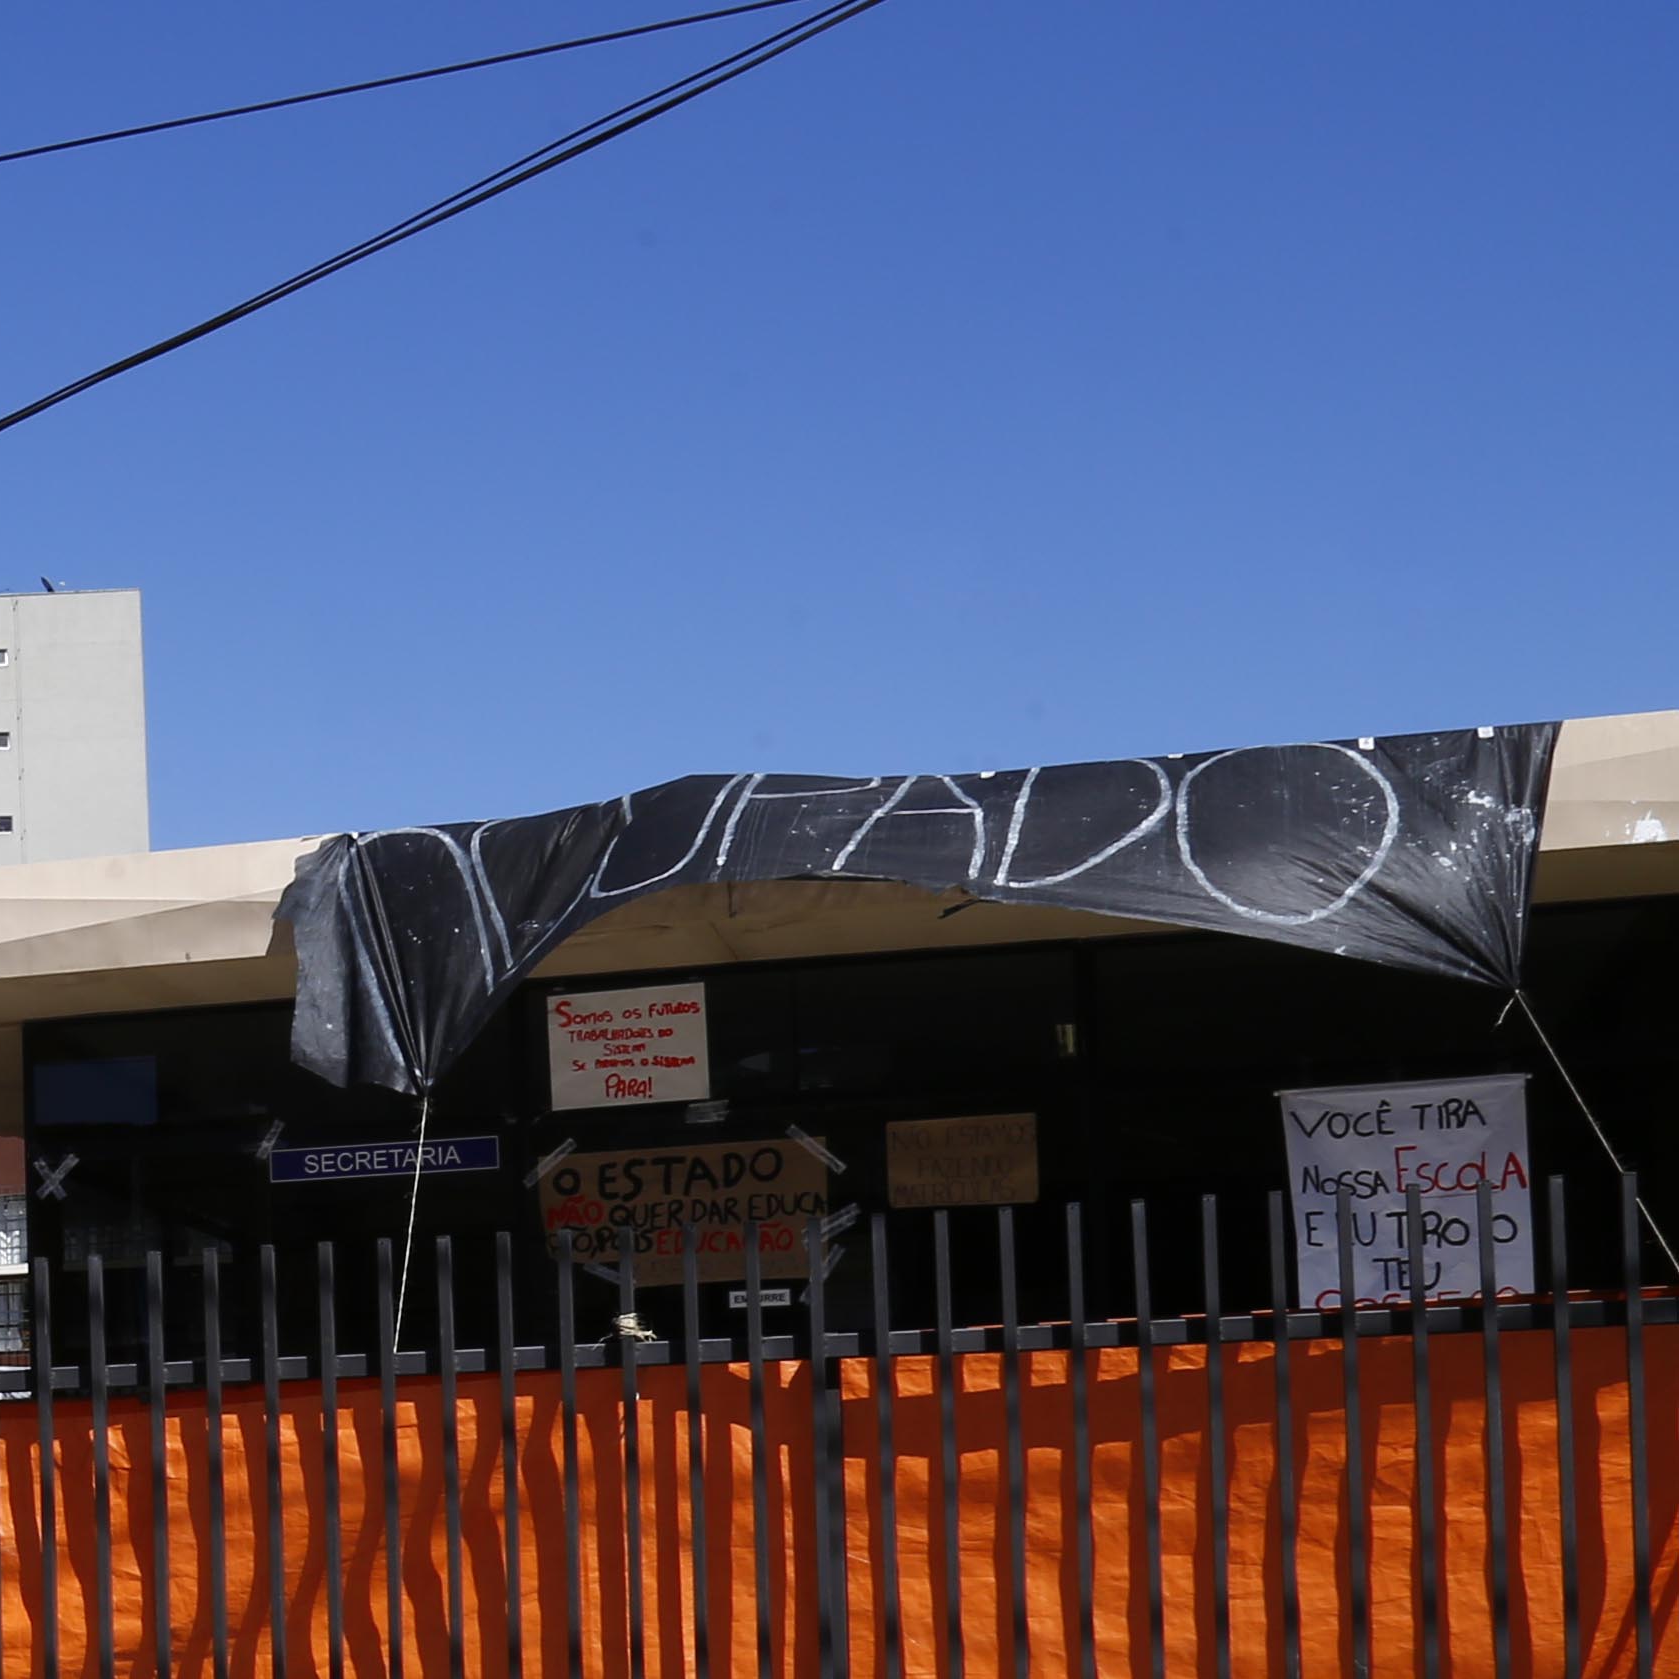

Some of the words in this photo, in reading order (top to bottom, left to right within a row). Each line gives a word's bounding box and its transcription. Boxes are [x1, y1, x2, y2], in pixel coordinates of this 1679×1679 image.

[605, 1073, 654, 1099] PARA!
[1288, 1099, 1396, 1139] VOCÊ
[1410, 1097, 1487, 1131] TIRA
[303, 1145, 462, 1174] SECRETARIA
[552, 1167, 582, 1197] O
[597, 1147, 784, 1201] ESTADO
[1393, 1145, 1529, 1194] ESCOLA
[545, 1194, 605, 1231] NÃO
[607, 1201, 686, 1231] QUER
[690, 1197, 742, 1224] DAR
[748, 1192, 826, 1222] EDUCA
